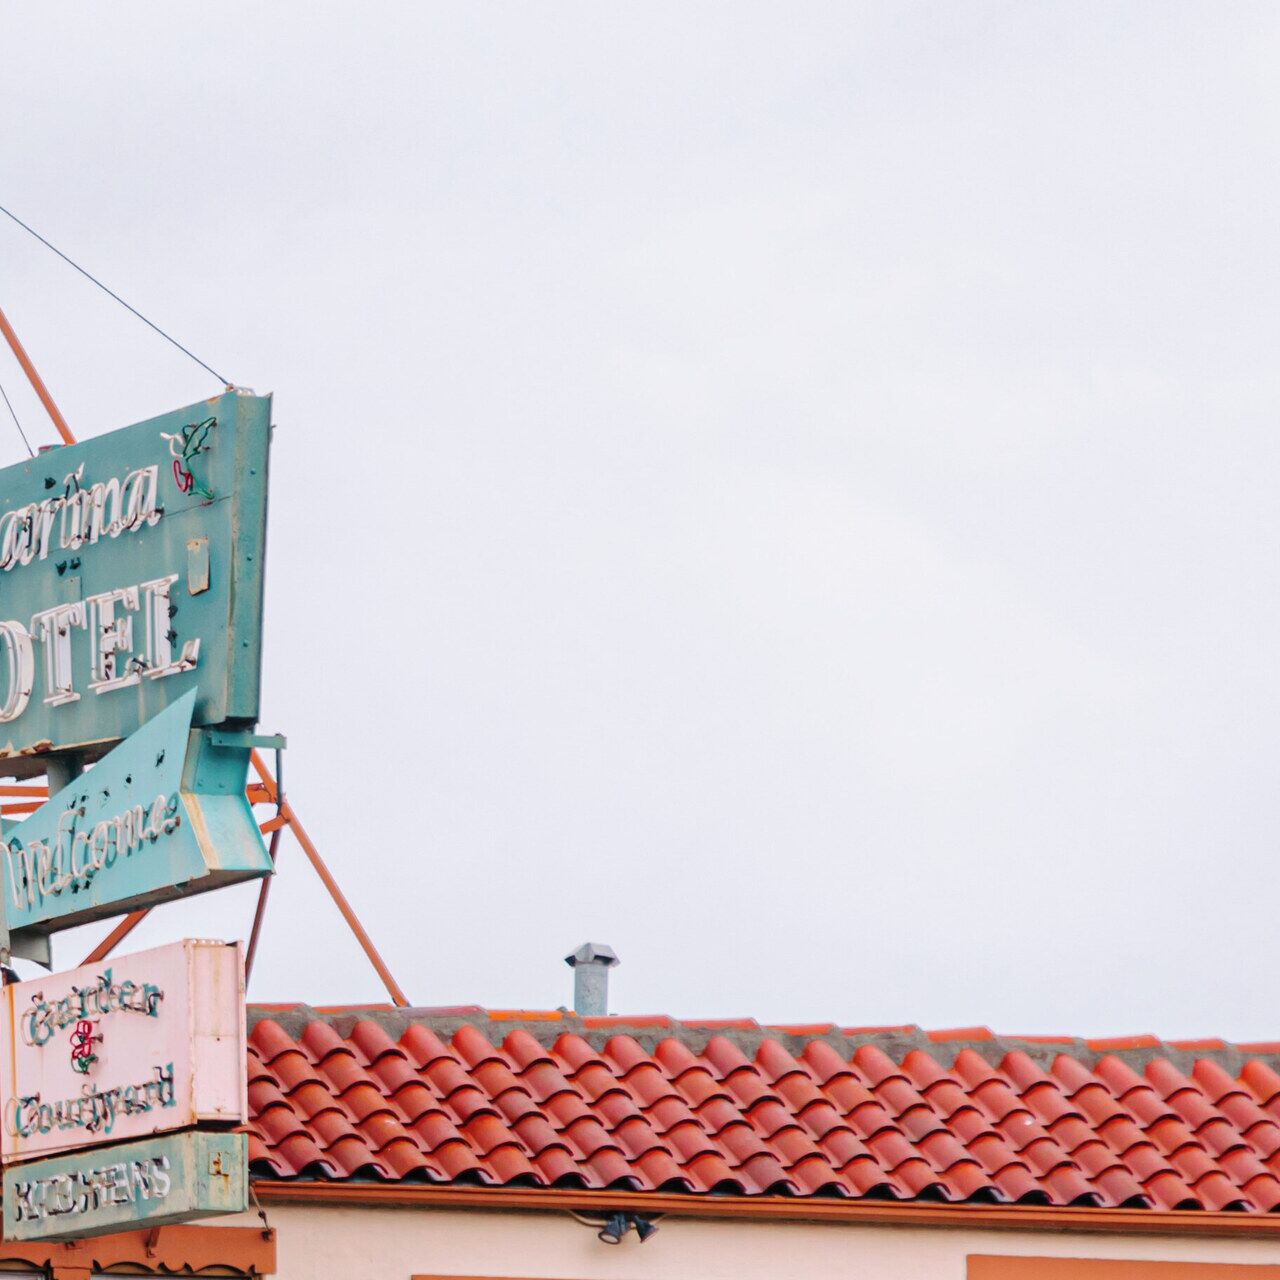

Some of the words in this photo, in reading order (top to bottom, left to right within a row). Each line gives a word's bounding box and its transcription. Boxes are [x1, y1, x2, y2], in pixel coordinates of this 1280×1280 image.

[21, 968, 163, 1047] Garden
[5, 1062, 176, 1138] Courtyard
[15, 1155, 171, 1221] KITCHENS
